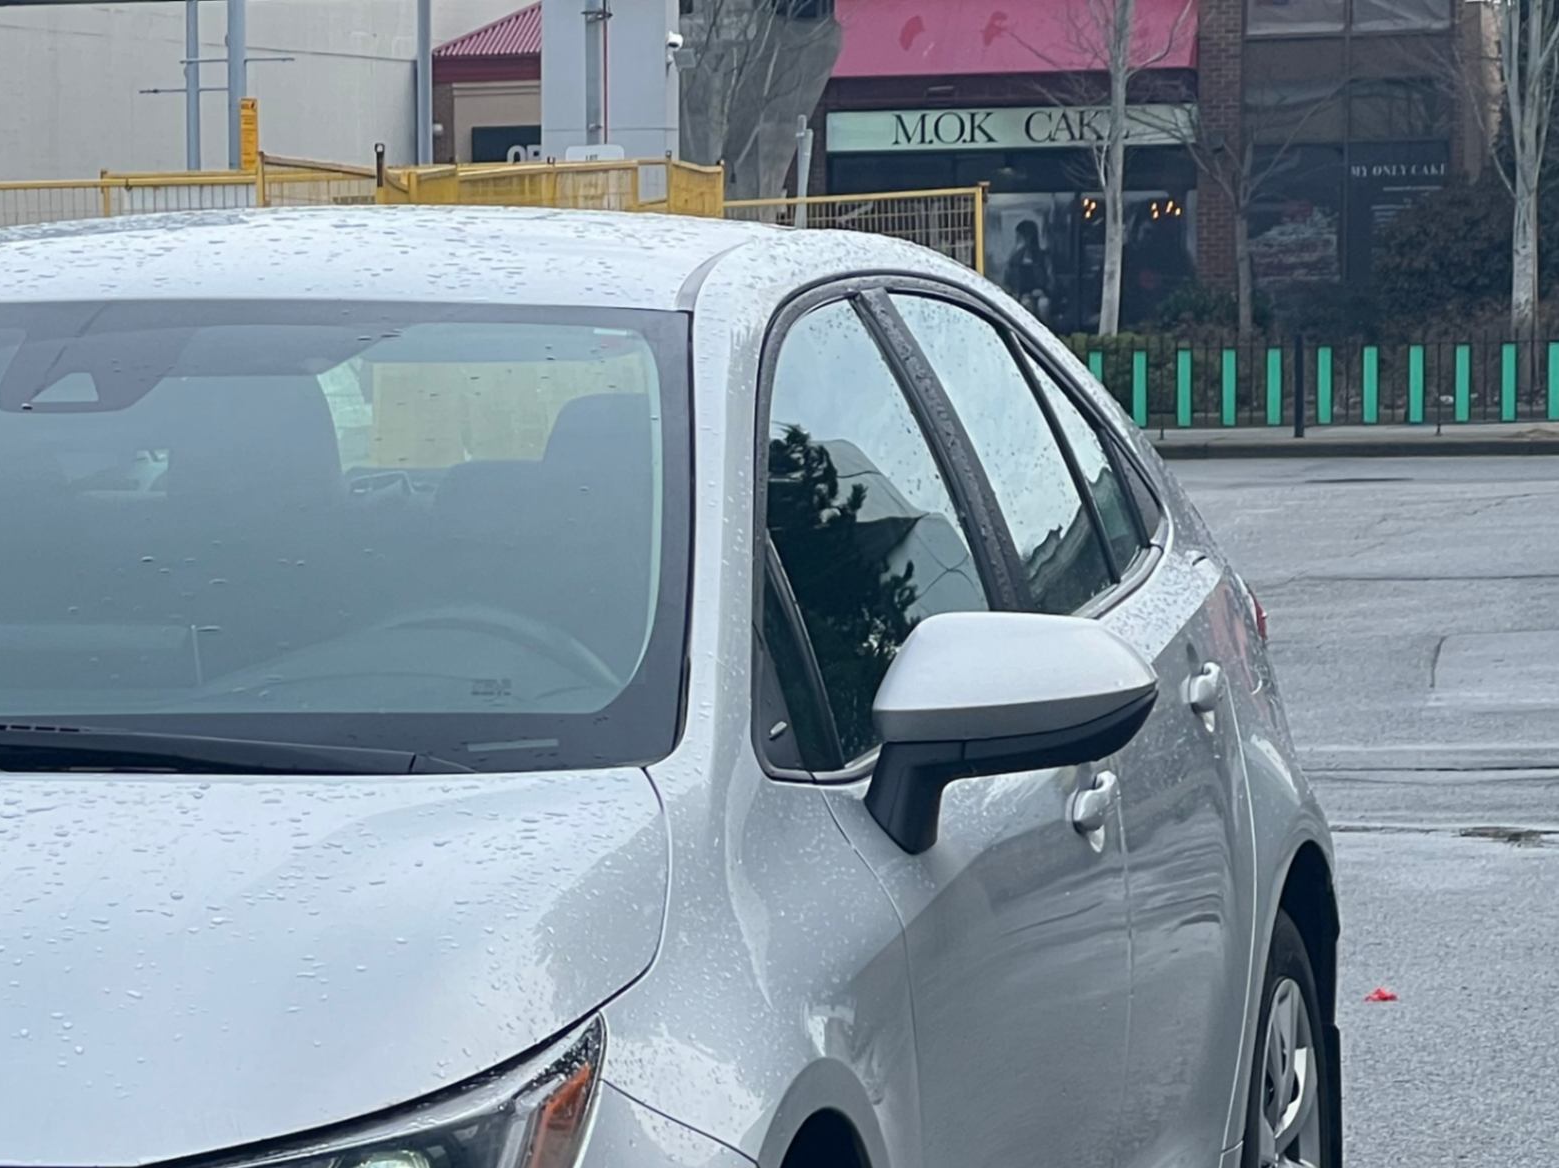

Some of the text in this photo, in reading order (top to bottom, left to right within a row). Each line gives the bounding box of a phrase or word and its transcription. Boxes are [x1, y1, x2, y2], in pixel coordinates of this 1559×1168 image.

[892, 109, 1130, 145] M.O.K CAK
[1351, 165, 1368, 177] MY
